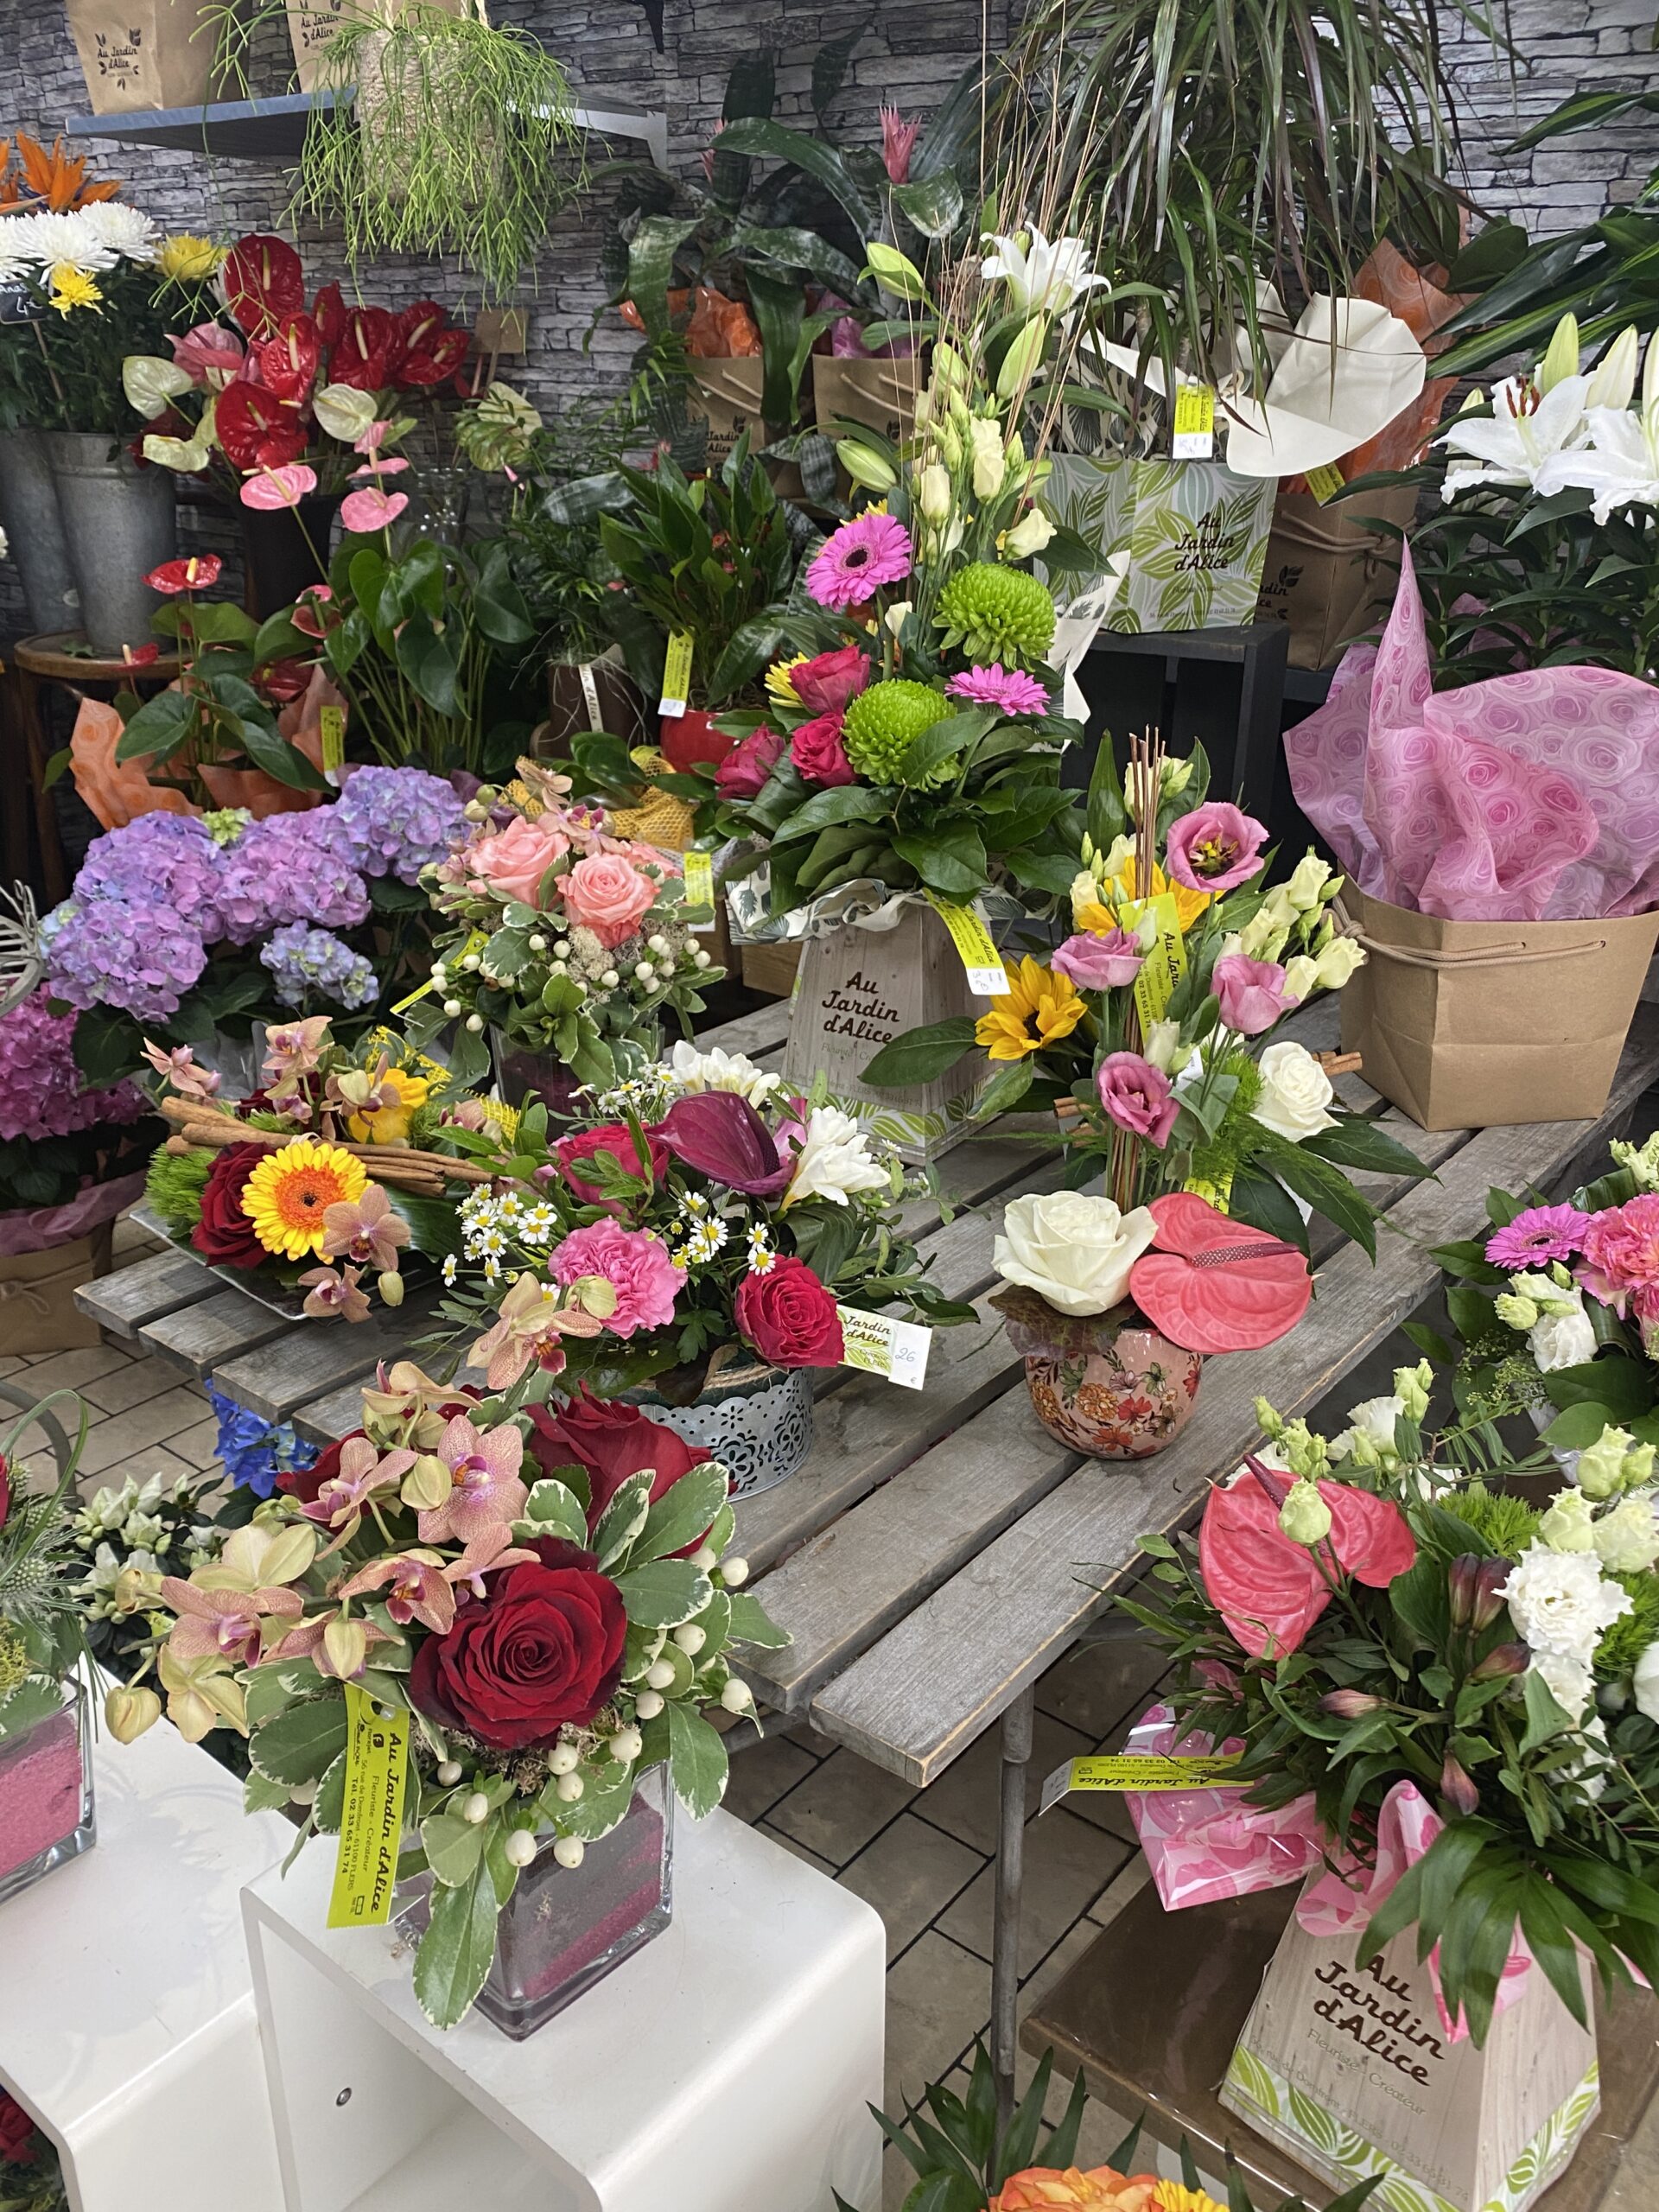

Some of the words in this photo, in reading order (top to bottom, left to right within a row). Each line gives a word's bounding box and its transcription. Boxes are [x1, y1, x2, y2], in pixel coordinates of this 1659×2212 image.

[98, 48, 109, 59] Au
[111, 45, 137, 57] Jardin
[1197, 512, 1223, 529] Au
[1175, 533, 1234, 550] Jardin
[1164, 931, 1176, 953] Au
[1167, 956, 1181, 988] Jar
[845, 971, 879, 995] Au
[822, 990, 900, 1023] Jardin
[823, 1014, 893, 1044] d'Alice
[844, 1315, 891, 1335] Jardin
[847, 1330, 889, 1347] d'Alice
[895, 1347, 916, 1363] 26
[389, 1732, 402, 1763] Au
[362, 1759, 368, 1770] 56
[359, 1785, 365, 1795] de
[1077, 1777, 1124, 1786] d'Alice
[1128, 1777, 1183, 1787] Jardin
[1187, 1777, 1210, 1785] Au
[349, 1798, 356, 1811] 02
[369, 1776, 379, 1818] Fleuriste
[382, 1768, 399, 1841] Jardin
[347, 1815, 355, 1827] 33
[355, 1796, 365, 1832] Domfront
[346, 1829, 353, 1842] 65
[344, 1846, 352, 1857] 31
[363, 1827, 374, 1872] Créateur
[341, 1861, 349, 1874] 74
[347, 1865, 357, 1891] FLERS
[371, 1846, 391, 1913] d'Alice
[1365, 1954, 1414, 2002] Au
[1314, 1961, 1446, 2060] Jardin
[1313, 1999, 1431, 2087] d'Alice
[1307, 2028, 1360, 2071] Fleuriste
[1369, 2071, 1427, 2116] Créateur
